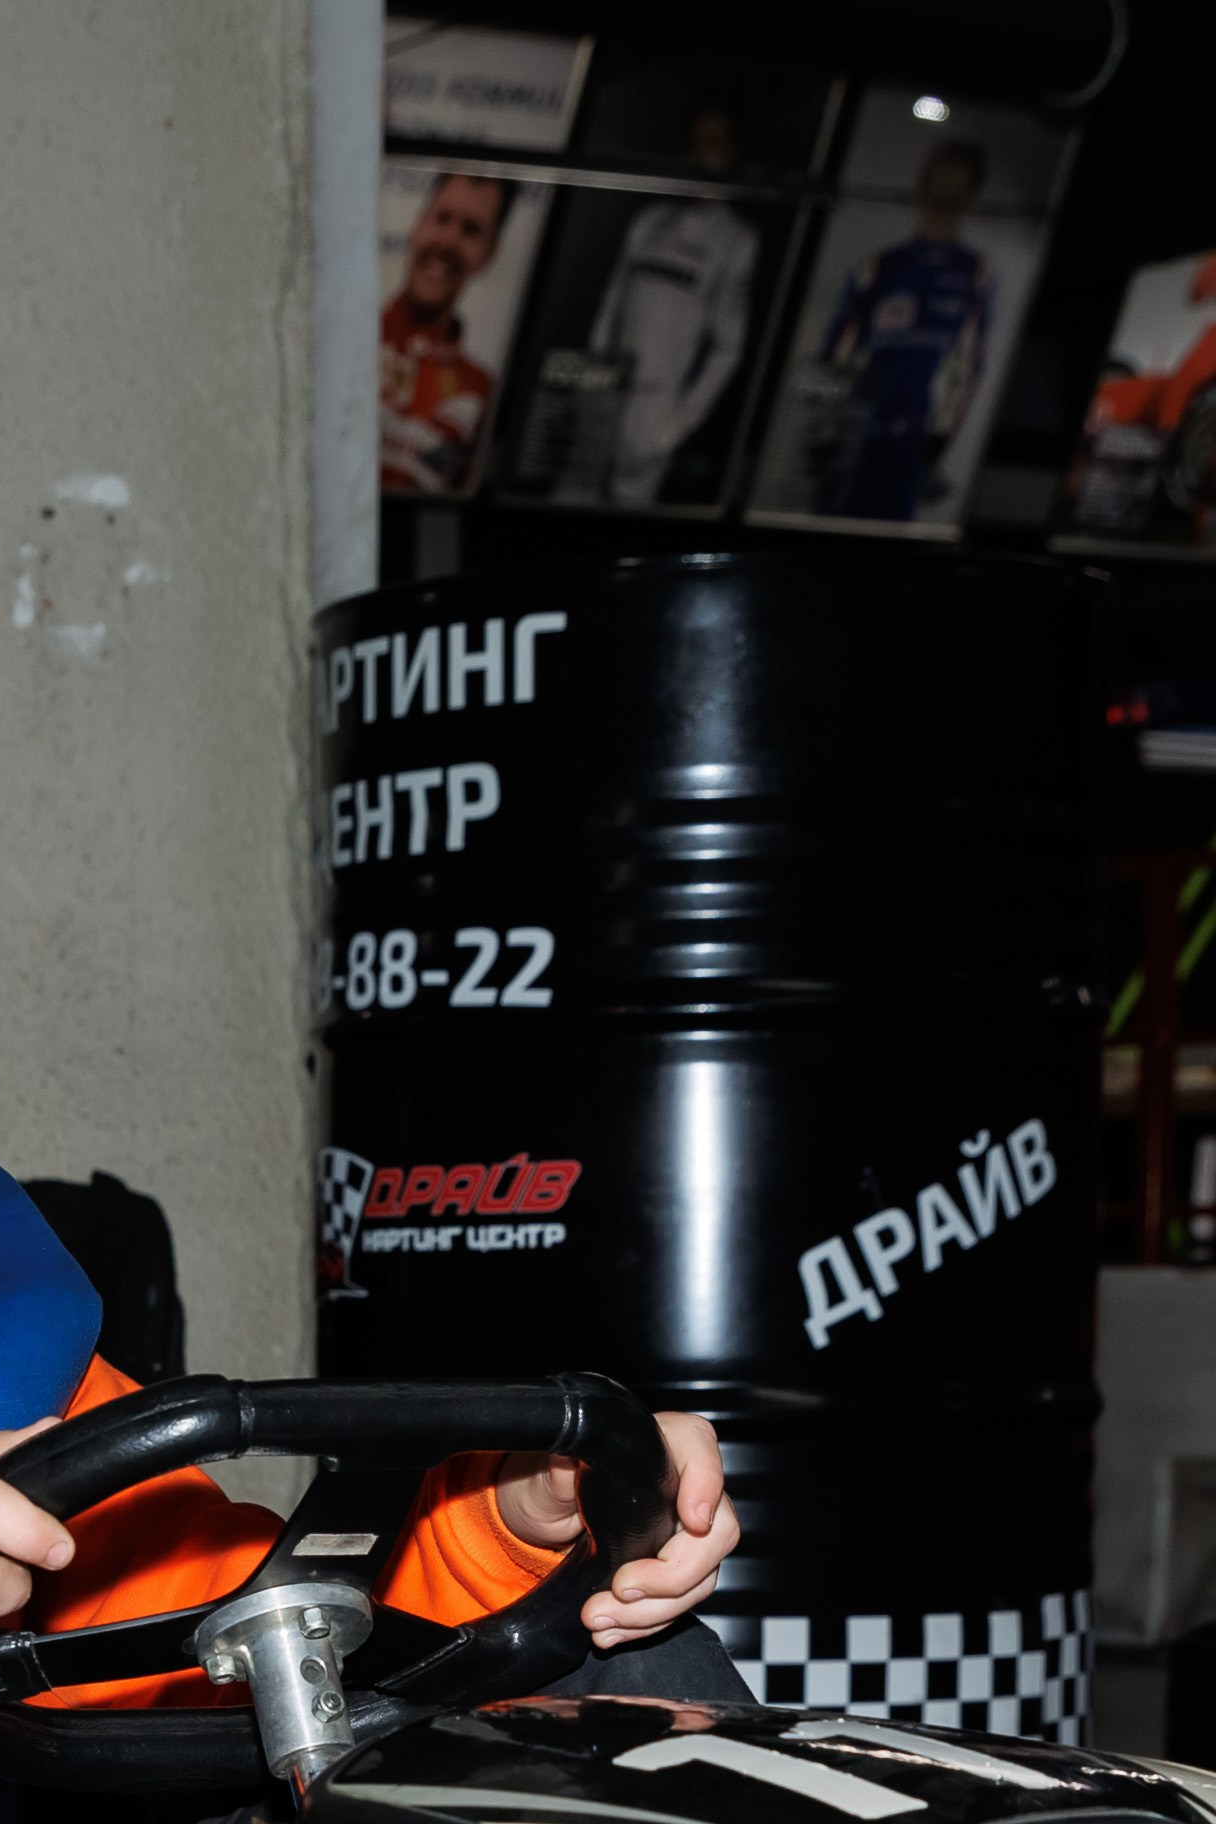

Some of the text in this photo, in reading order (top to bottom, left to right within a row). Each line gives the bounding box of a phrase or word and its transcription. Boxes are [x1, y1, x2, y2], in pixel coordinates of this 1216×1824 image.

[364, 1152, 582, 1218] ДРАЙВ
[466, 1222, 567, 1253] ЦЕНТР
[797, 1117, 1058, 1350] ДРАЙВ
